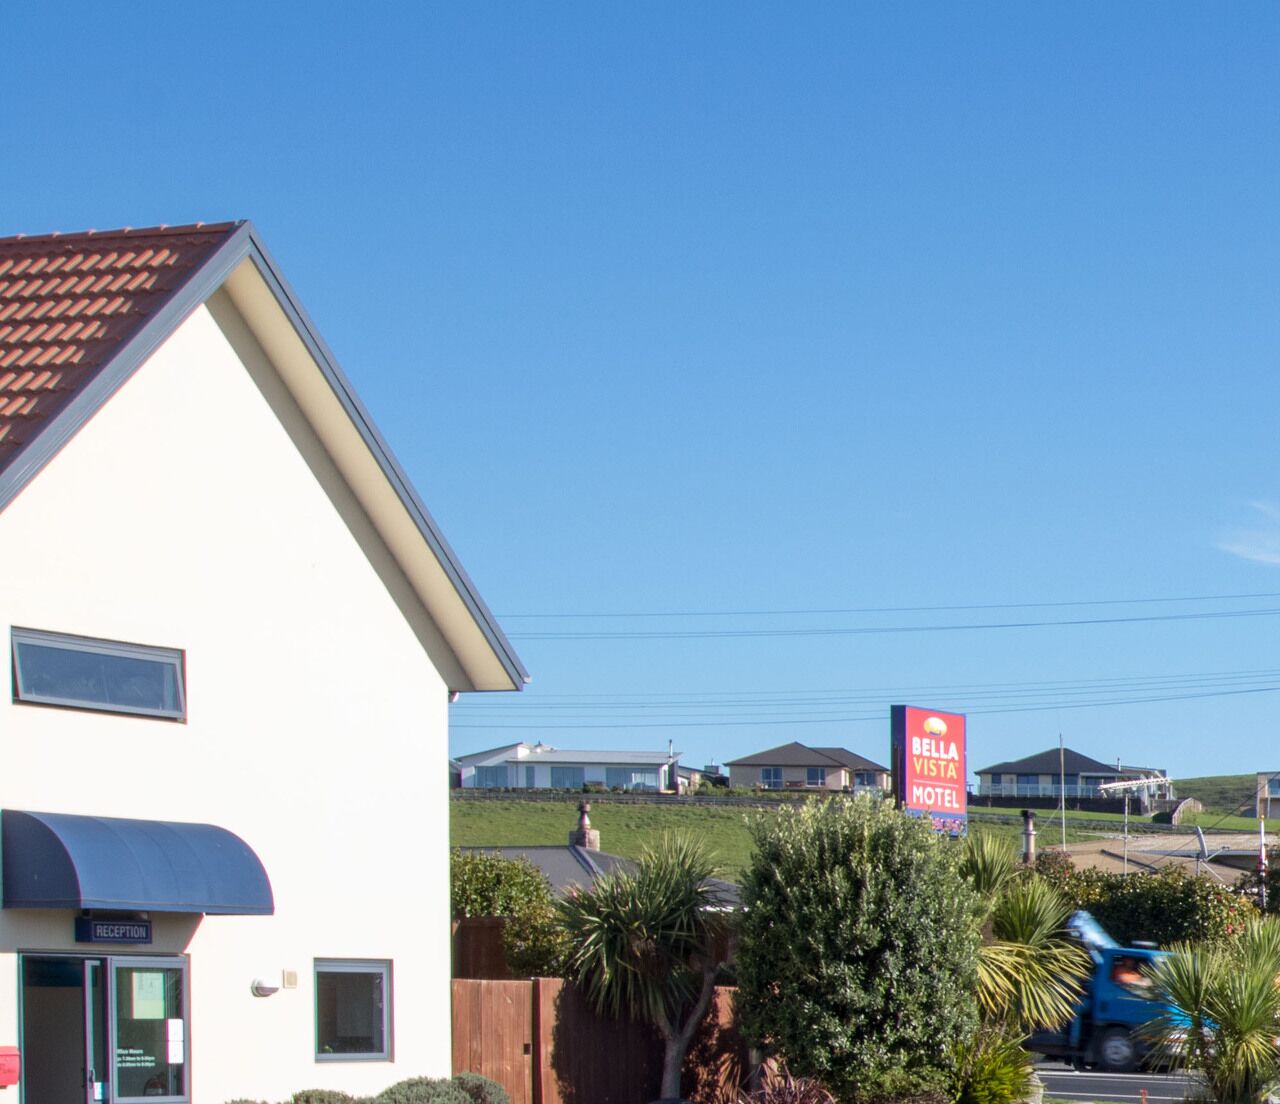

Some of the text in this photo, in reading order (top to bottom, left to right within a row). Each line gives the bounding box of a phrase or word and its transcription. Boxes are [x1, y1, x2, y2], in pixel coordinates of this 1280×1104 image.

[912, 736, 959, 760] BELLA
[913, 757, 957, 779] VISTA
[912, 785, 960, 809] MOTEL
[96, 925, 147, 938] RECEPTION
